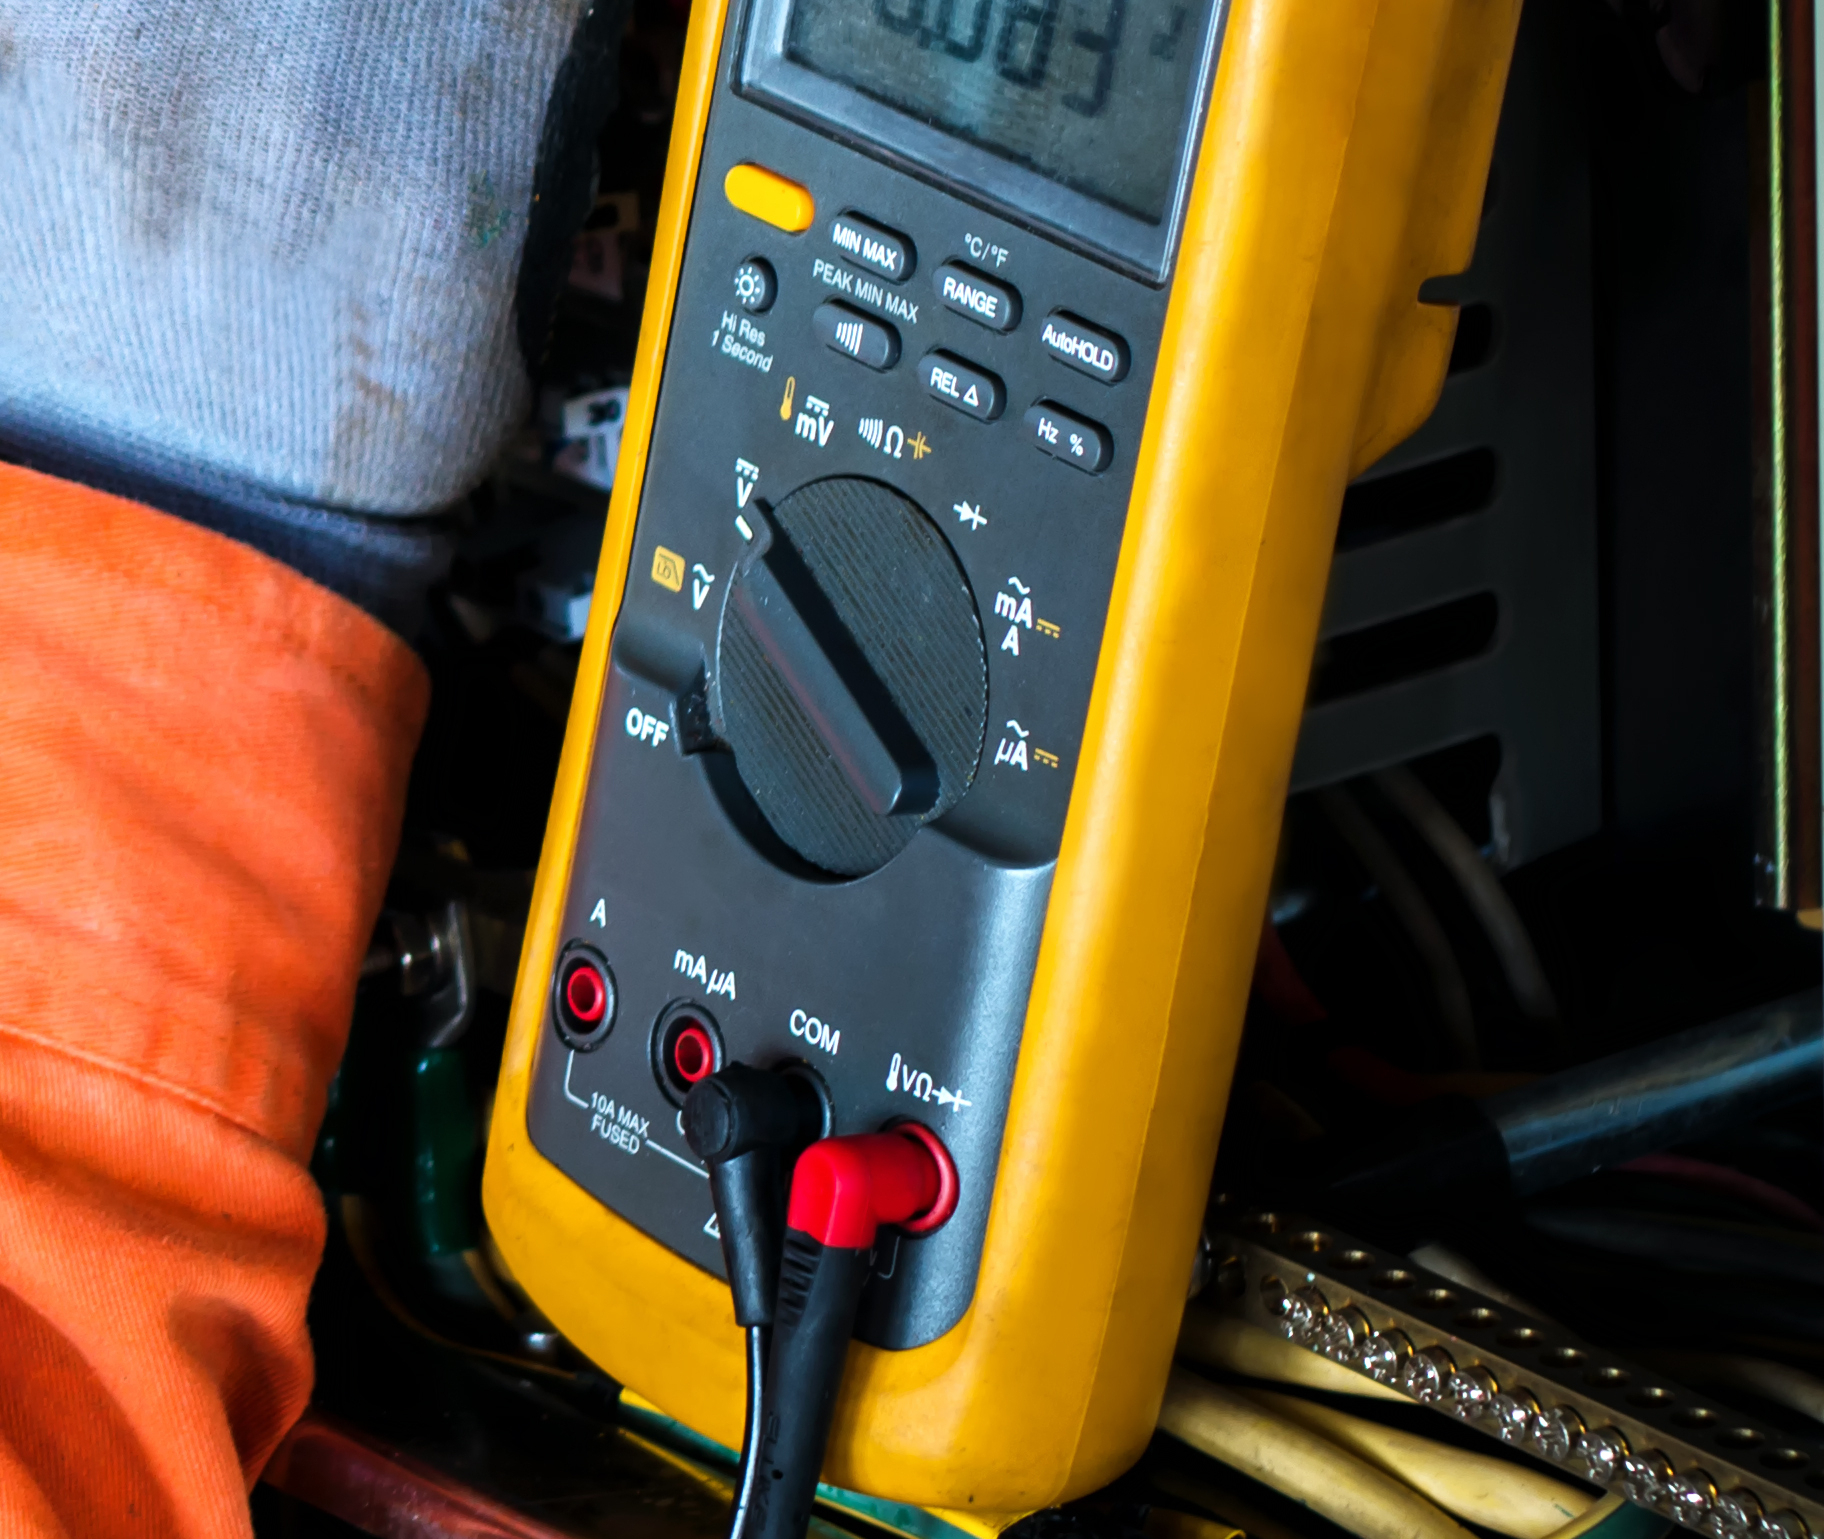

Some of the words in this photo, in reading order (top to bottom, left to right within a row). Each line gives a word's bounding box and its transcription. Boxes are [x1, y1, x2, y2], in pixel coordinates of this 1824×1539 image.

[832, 222, 862, 254] MIN
[863, 237, 898, 271] MAX
[812, 258, 854, 293] PEAK
[855, 277, 884, 307] MIN
[885, 292, 920, 324] MAX
[943, 276, 998, 318] RANGE
[721, 310, 737, 333] Hi
[739, 318, 766, 347] Res
[1041, 323, 1114, 371] AutoHOLD
[711, 329, 720, 347] 1
[721, 335, 773, 373] Second
[930, 366, 960, 398] REL
[795, 412, 834, 448] mV
[1037, 417, 1059, 444] Hz
[1069, 433, 1084, 456] %
[994, 591, 1033, 629] mA
[1001, 624, 1020, 656] A
[625, 708, 669, 747] OFF
[589, 898, 607, 928] A
[673, 948, 707, 985] mA
[789, 1008, 841, 1056] COM
[589, 1091, 616, 1121] 10A
[616, 1103, 651, 1139] MAX
[590, 1116, 641, 1156] FUSED
